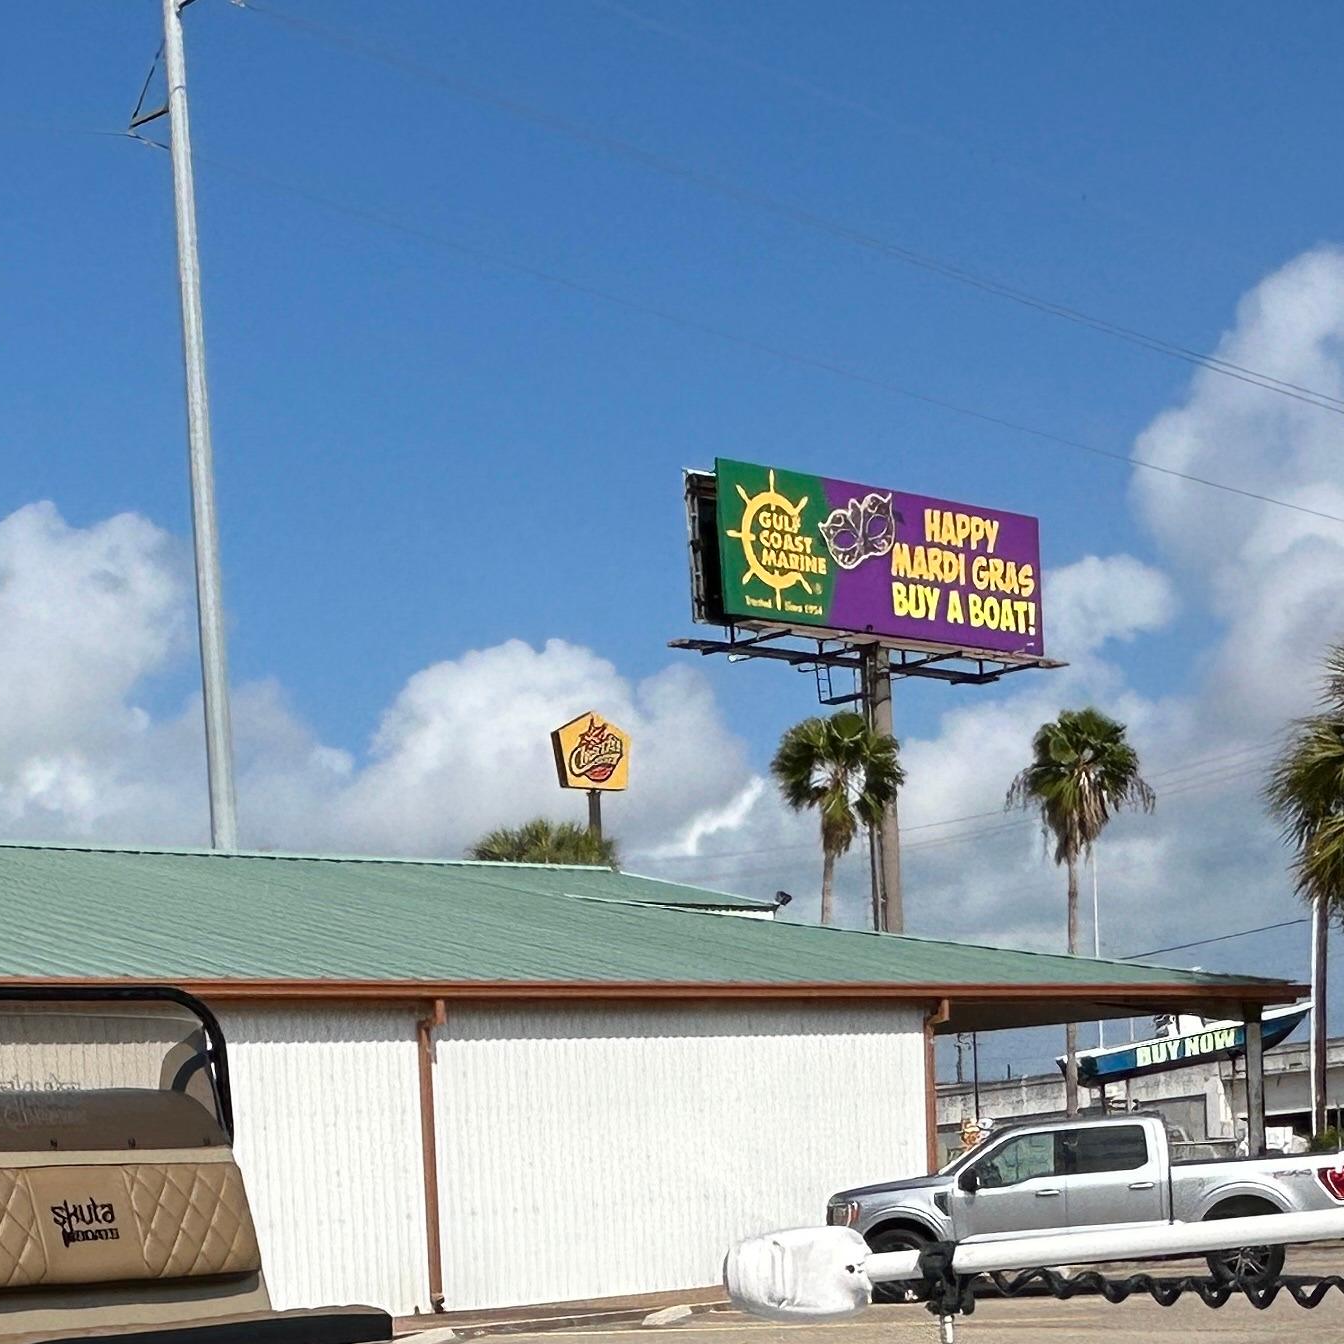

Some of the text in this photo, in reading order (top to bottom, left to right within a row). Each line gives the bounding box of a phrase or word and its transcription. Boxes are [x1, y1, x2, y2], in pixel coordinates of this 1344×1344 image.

[759, 511, 801, 533] GULF
[924, 509, 999, 553] HAPPY
[759, 530, 812, 554] COAST
[761, 548, 827, 575] MARINE
[891, 542, 1035, 597] MARDI GRAS
[892, 582, 1036, 636] BUY A BOAT!
[1136, 1029, 1235, 1067] BUY NOW
